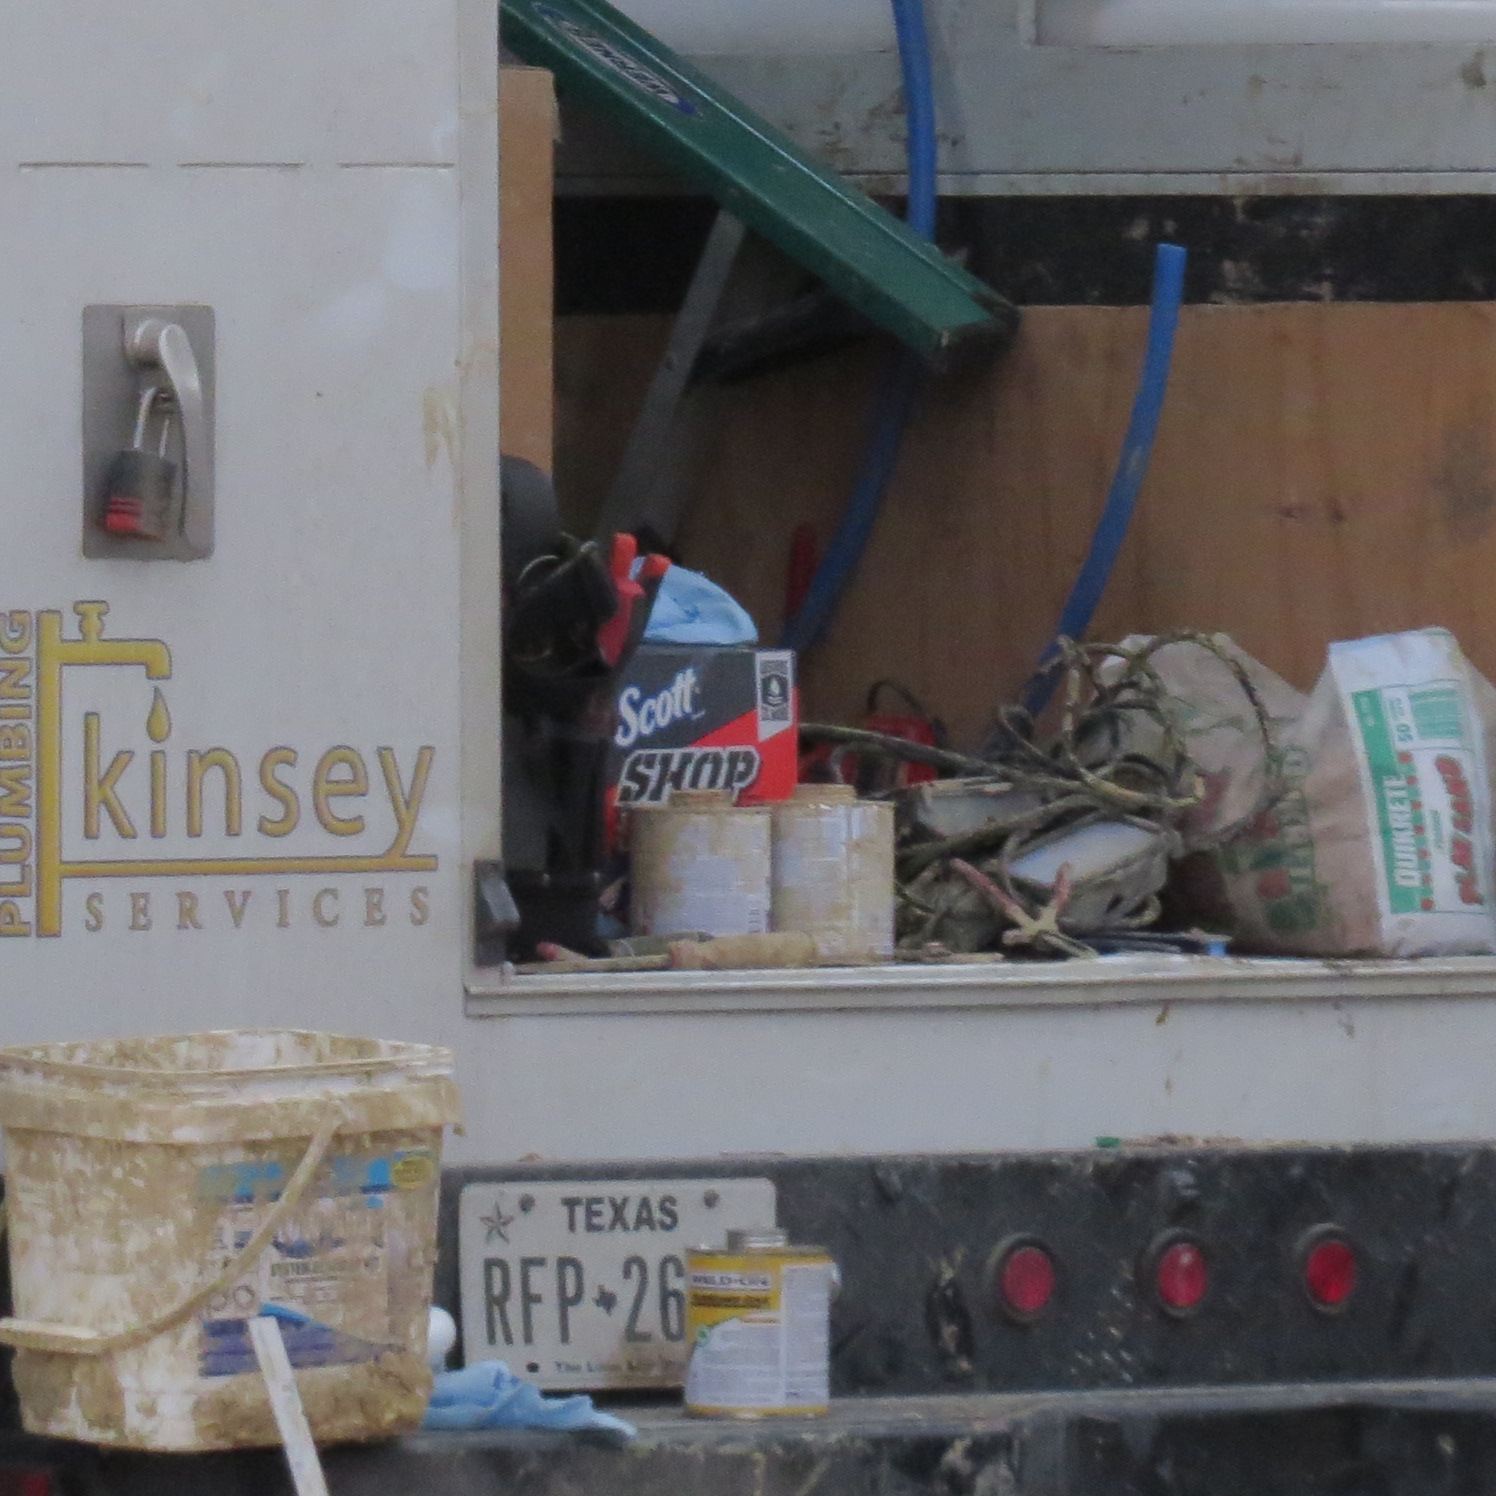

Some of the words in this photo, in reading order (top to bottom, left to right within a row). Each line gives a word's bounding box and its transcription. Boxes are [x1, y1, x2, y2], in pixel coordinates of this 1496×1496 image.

[614, 668, 698, 748] Scott
[83, 711, 436, 858] kinsey
[615, 745, 761, 807] SHOP
[85, 886, 430, 933] SERVICES
[561, 1196, 679, 1233] TEXAS
